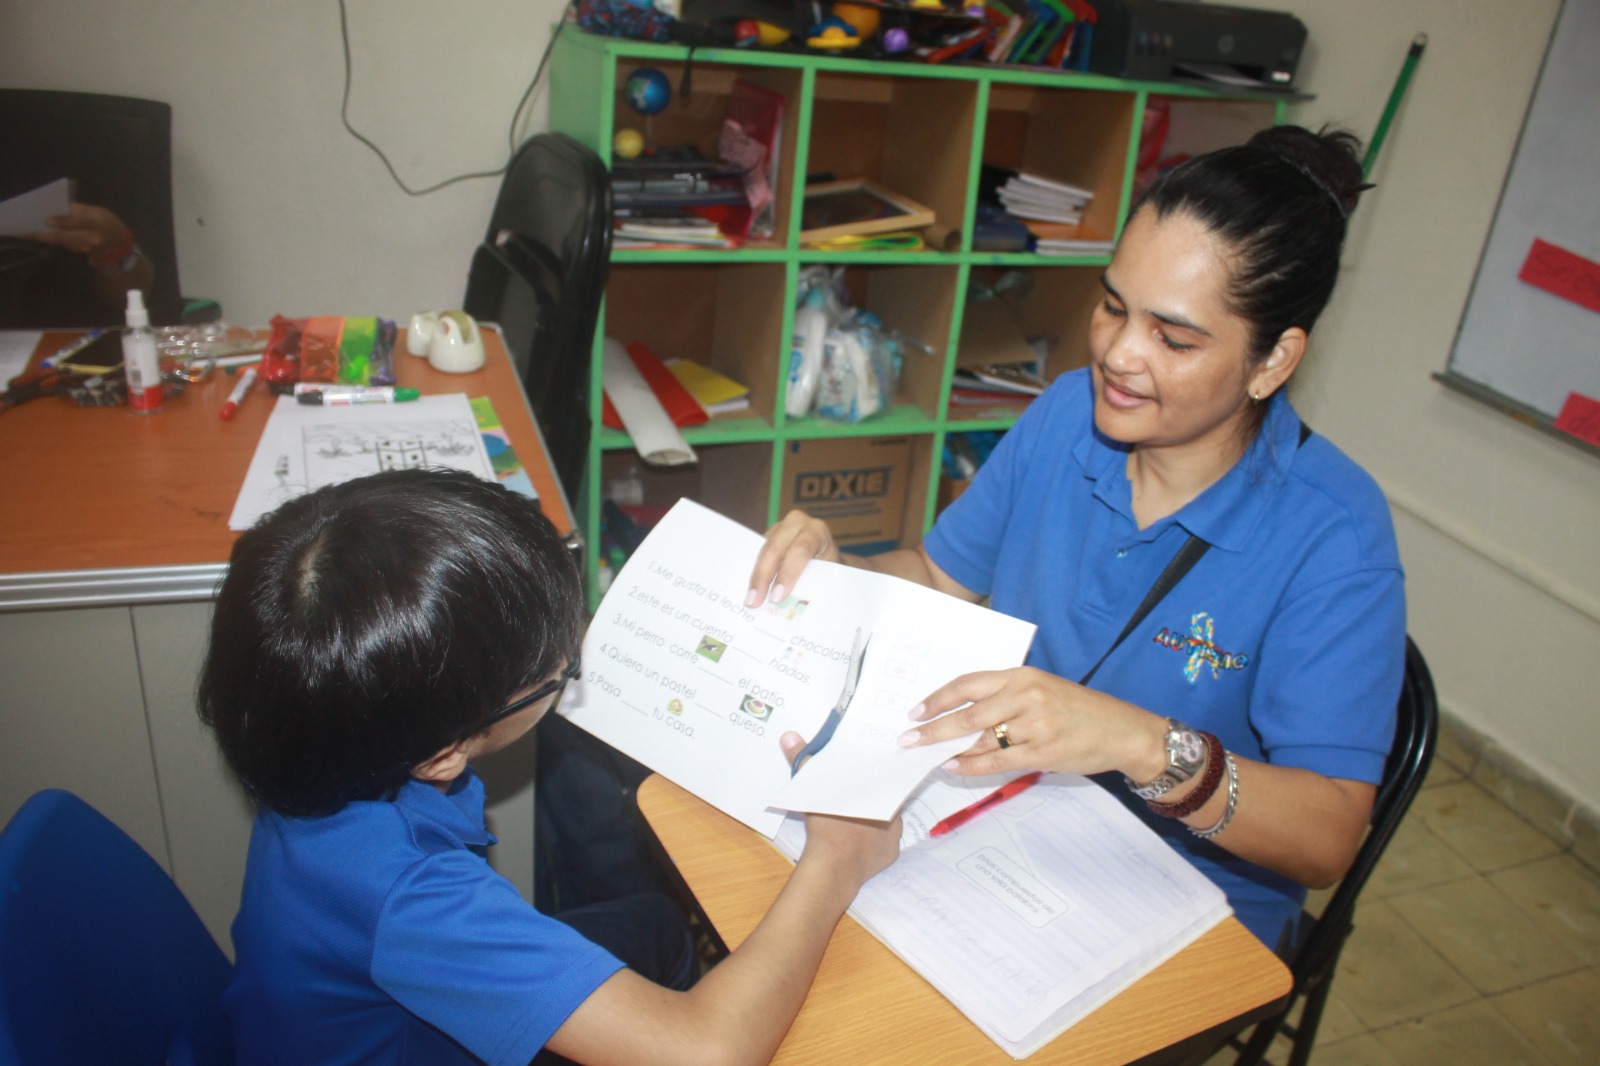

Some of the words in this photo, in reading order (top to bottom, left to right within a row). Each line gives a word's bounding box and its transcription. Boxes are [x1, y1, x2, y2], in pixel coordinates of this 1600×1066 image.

[799, 471, 886, 499] DIXIE
[661, 601, 673, 615] es
[675, 610, 690, 624] un
[691, 617, 733, 643] cuento
[674, 574, 704, 596] gusta
[705, 587, 718, 602] la
[719, 594, 755, 622] leche
[612, 613, 635, 633] 3.Mi
[636, 626, 665, 649] perro
[669, 643, 699, 665] corre
[738, 675, 749, 690] el
[586, 671, 622, 698] 5.Pasa
[652, 705, 663, 720] tu
[665, 715, 696, 740] casa.
[599, 643, 643, 672] 4.Quiero
[645, 668, 660, 683] un
[661, 676, 697, 701] pastel
[729, 711, 767, 740] queso.
